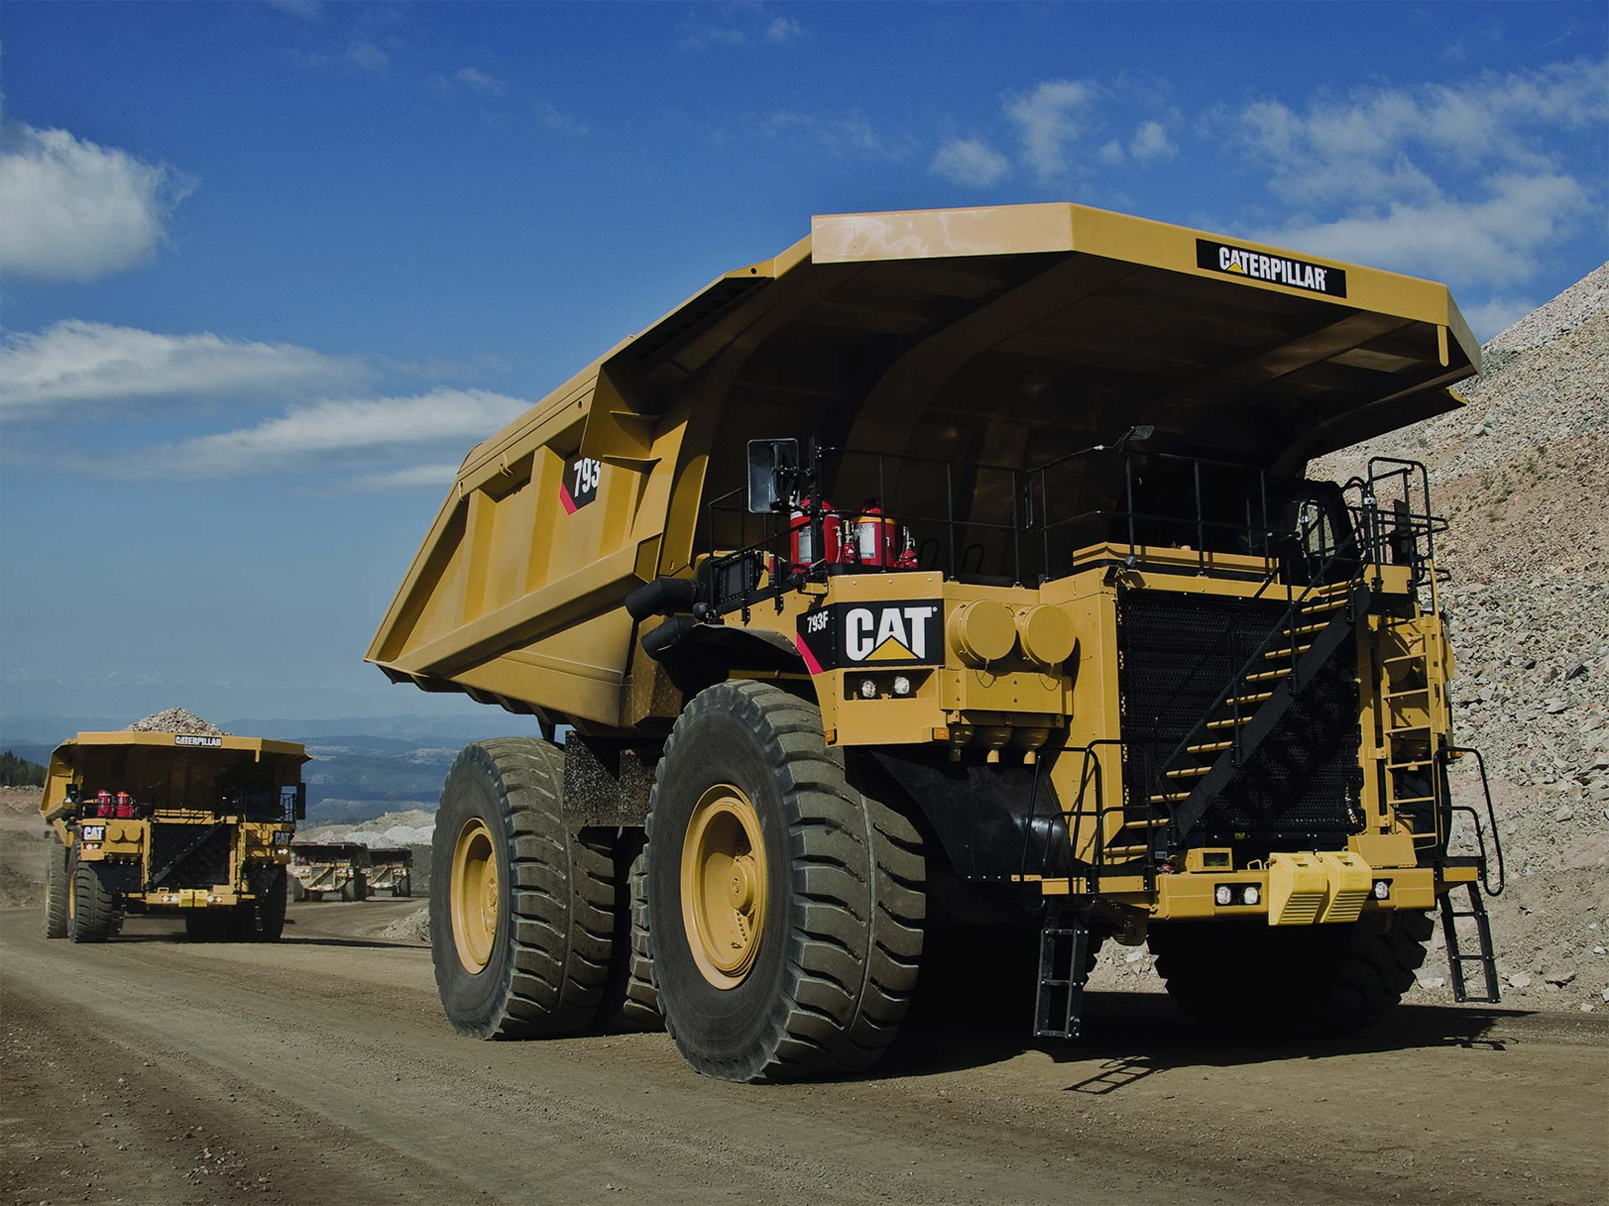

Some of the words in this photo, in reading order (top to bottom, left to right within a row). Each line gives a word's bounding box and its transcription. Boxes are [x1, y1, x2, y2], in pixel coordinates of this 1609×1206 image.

[1218, 246, 1327, 291] CATERPILLAR
[573, 457, 601, 498] 793
[806, 610, 829, 634] 793F
[845, 606, 935, 661] CAT
[175, 736, 222, 746] CATERPILLAR
[83, 826, 105, 840] CAT
[275, 831, 290, 845] CAT
